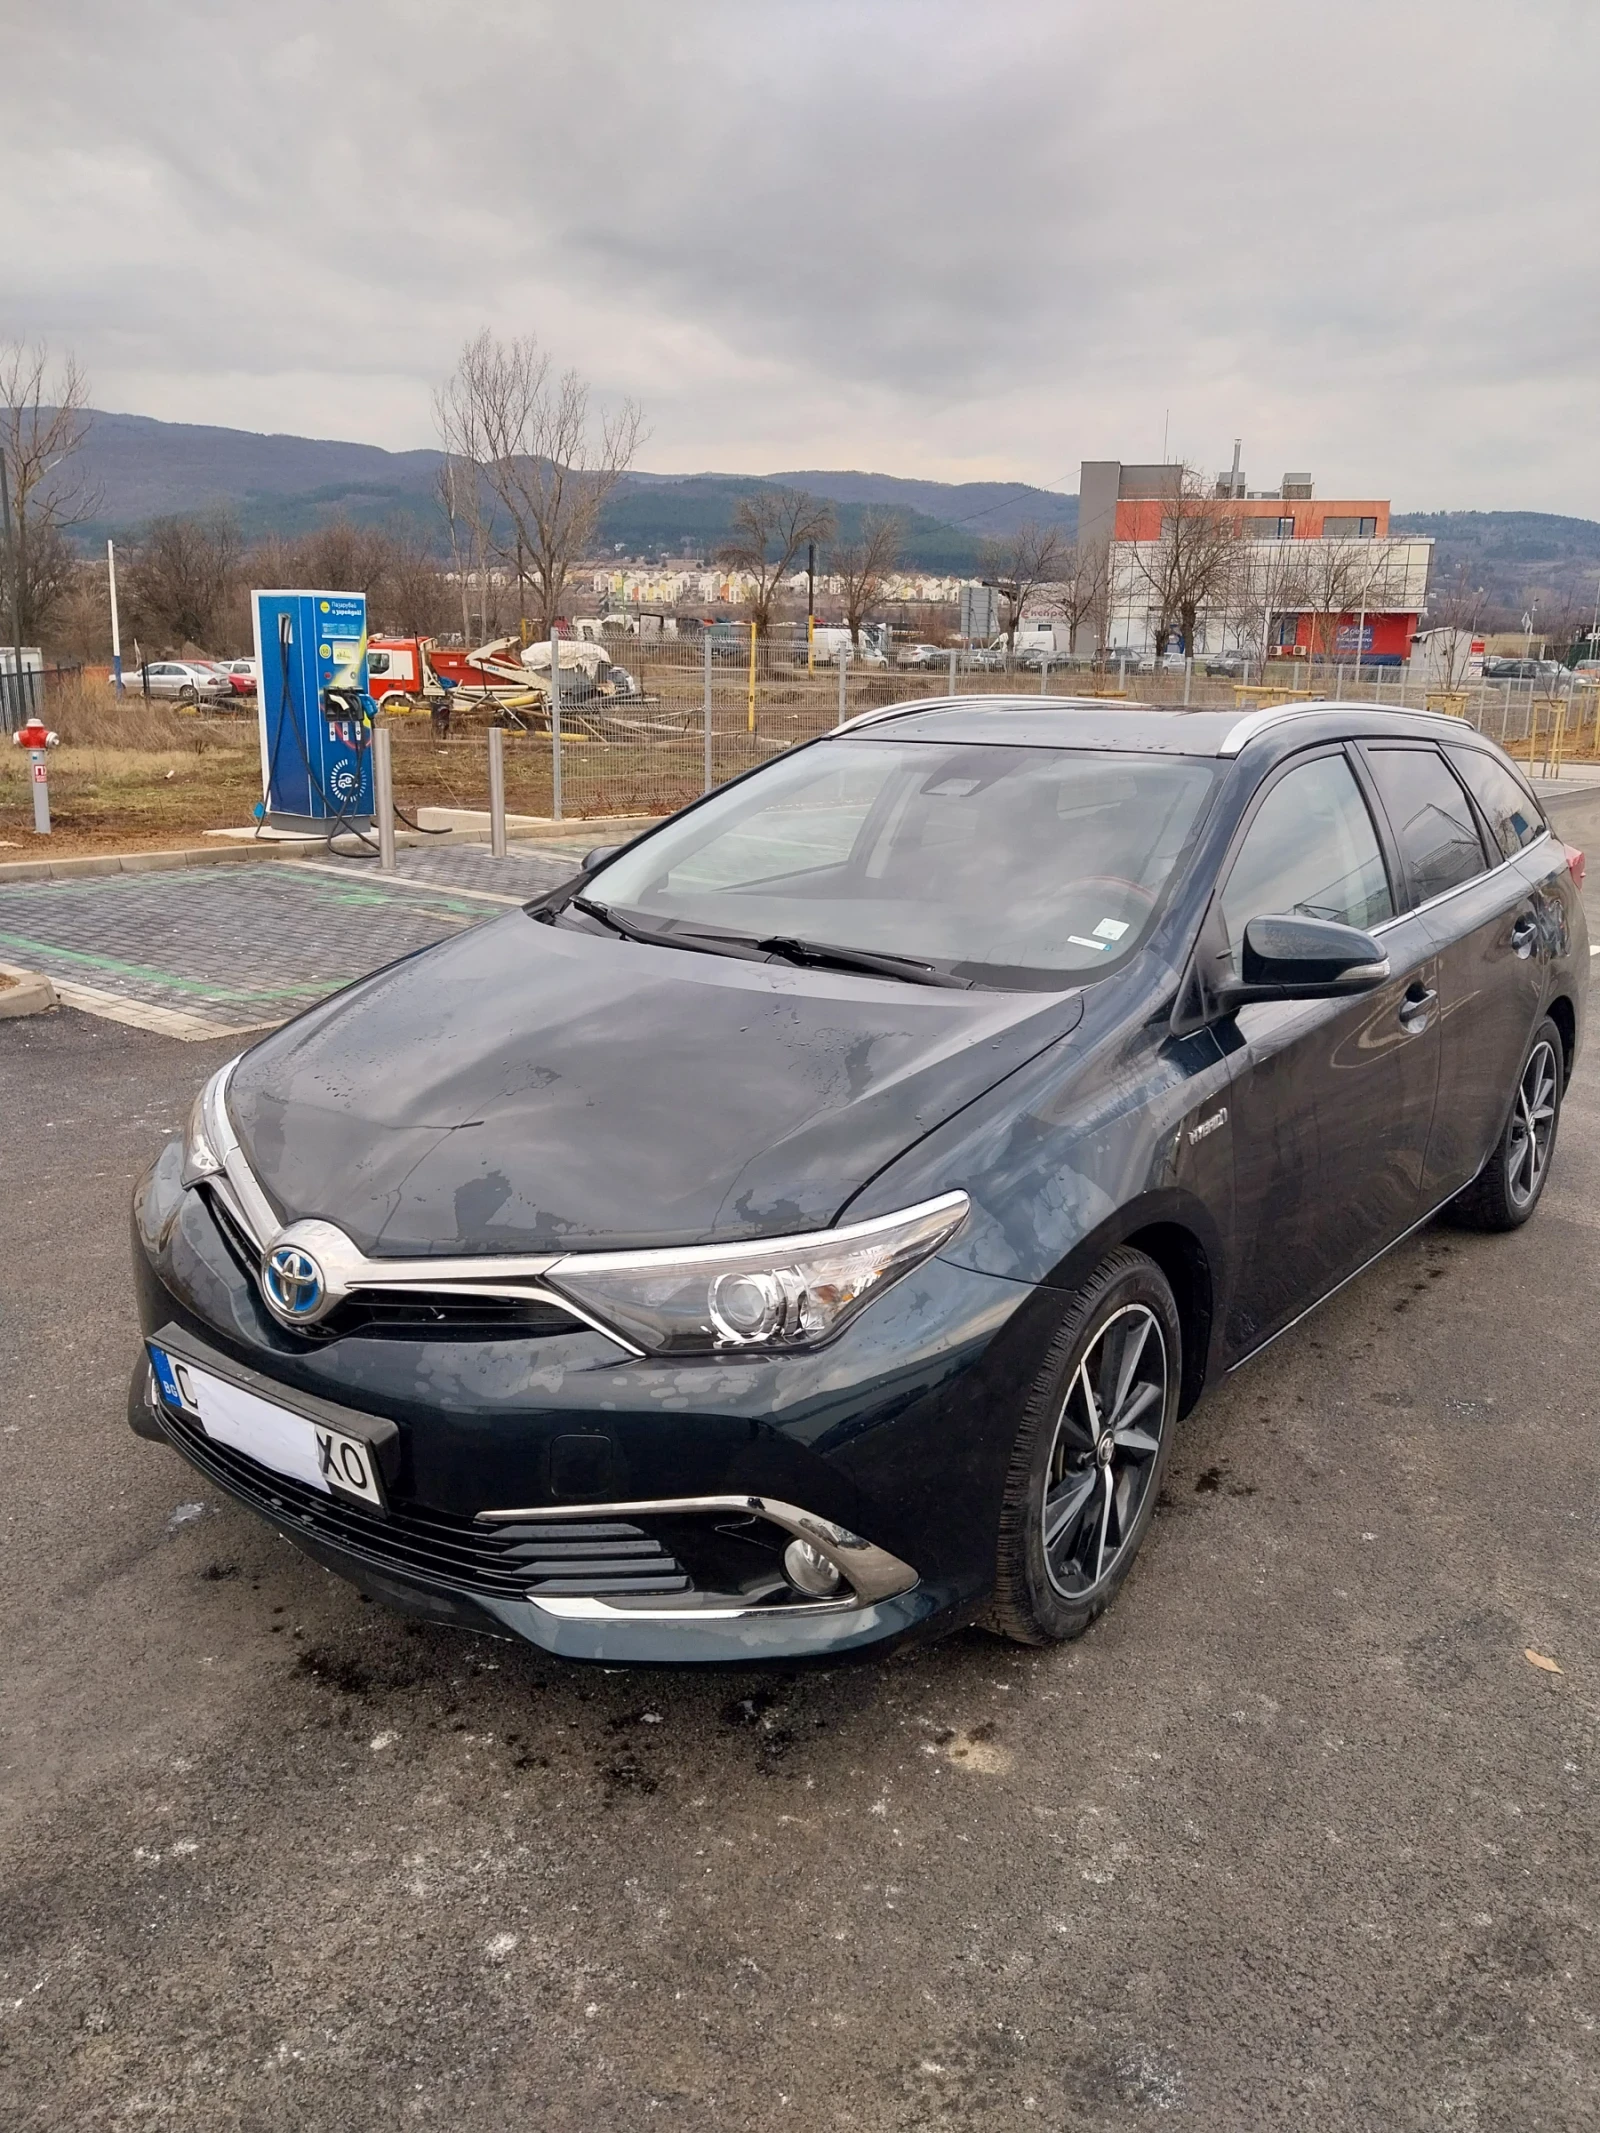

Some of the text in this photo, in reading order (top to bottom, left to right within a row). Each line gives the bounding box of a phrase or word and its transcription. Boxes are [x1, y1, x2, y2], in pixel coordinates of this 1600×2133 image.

[1350, 628, 1370, 636] pesi
[1187, 1107, 1228, 1145] HYBRID
[162, 1380, 178, 1398] BG
